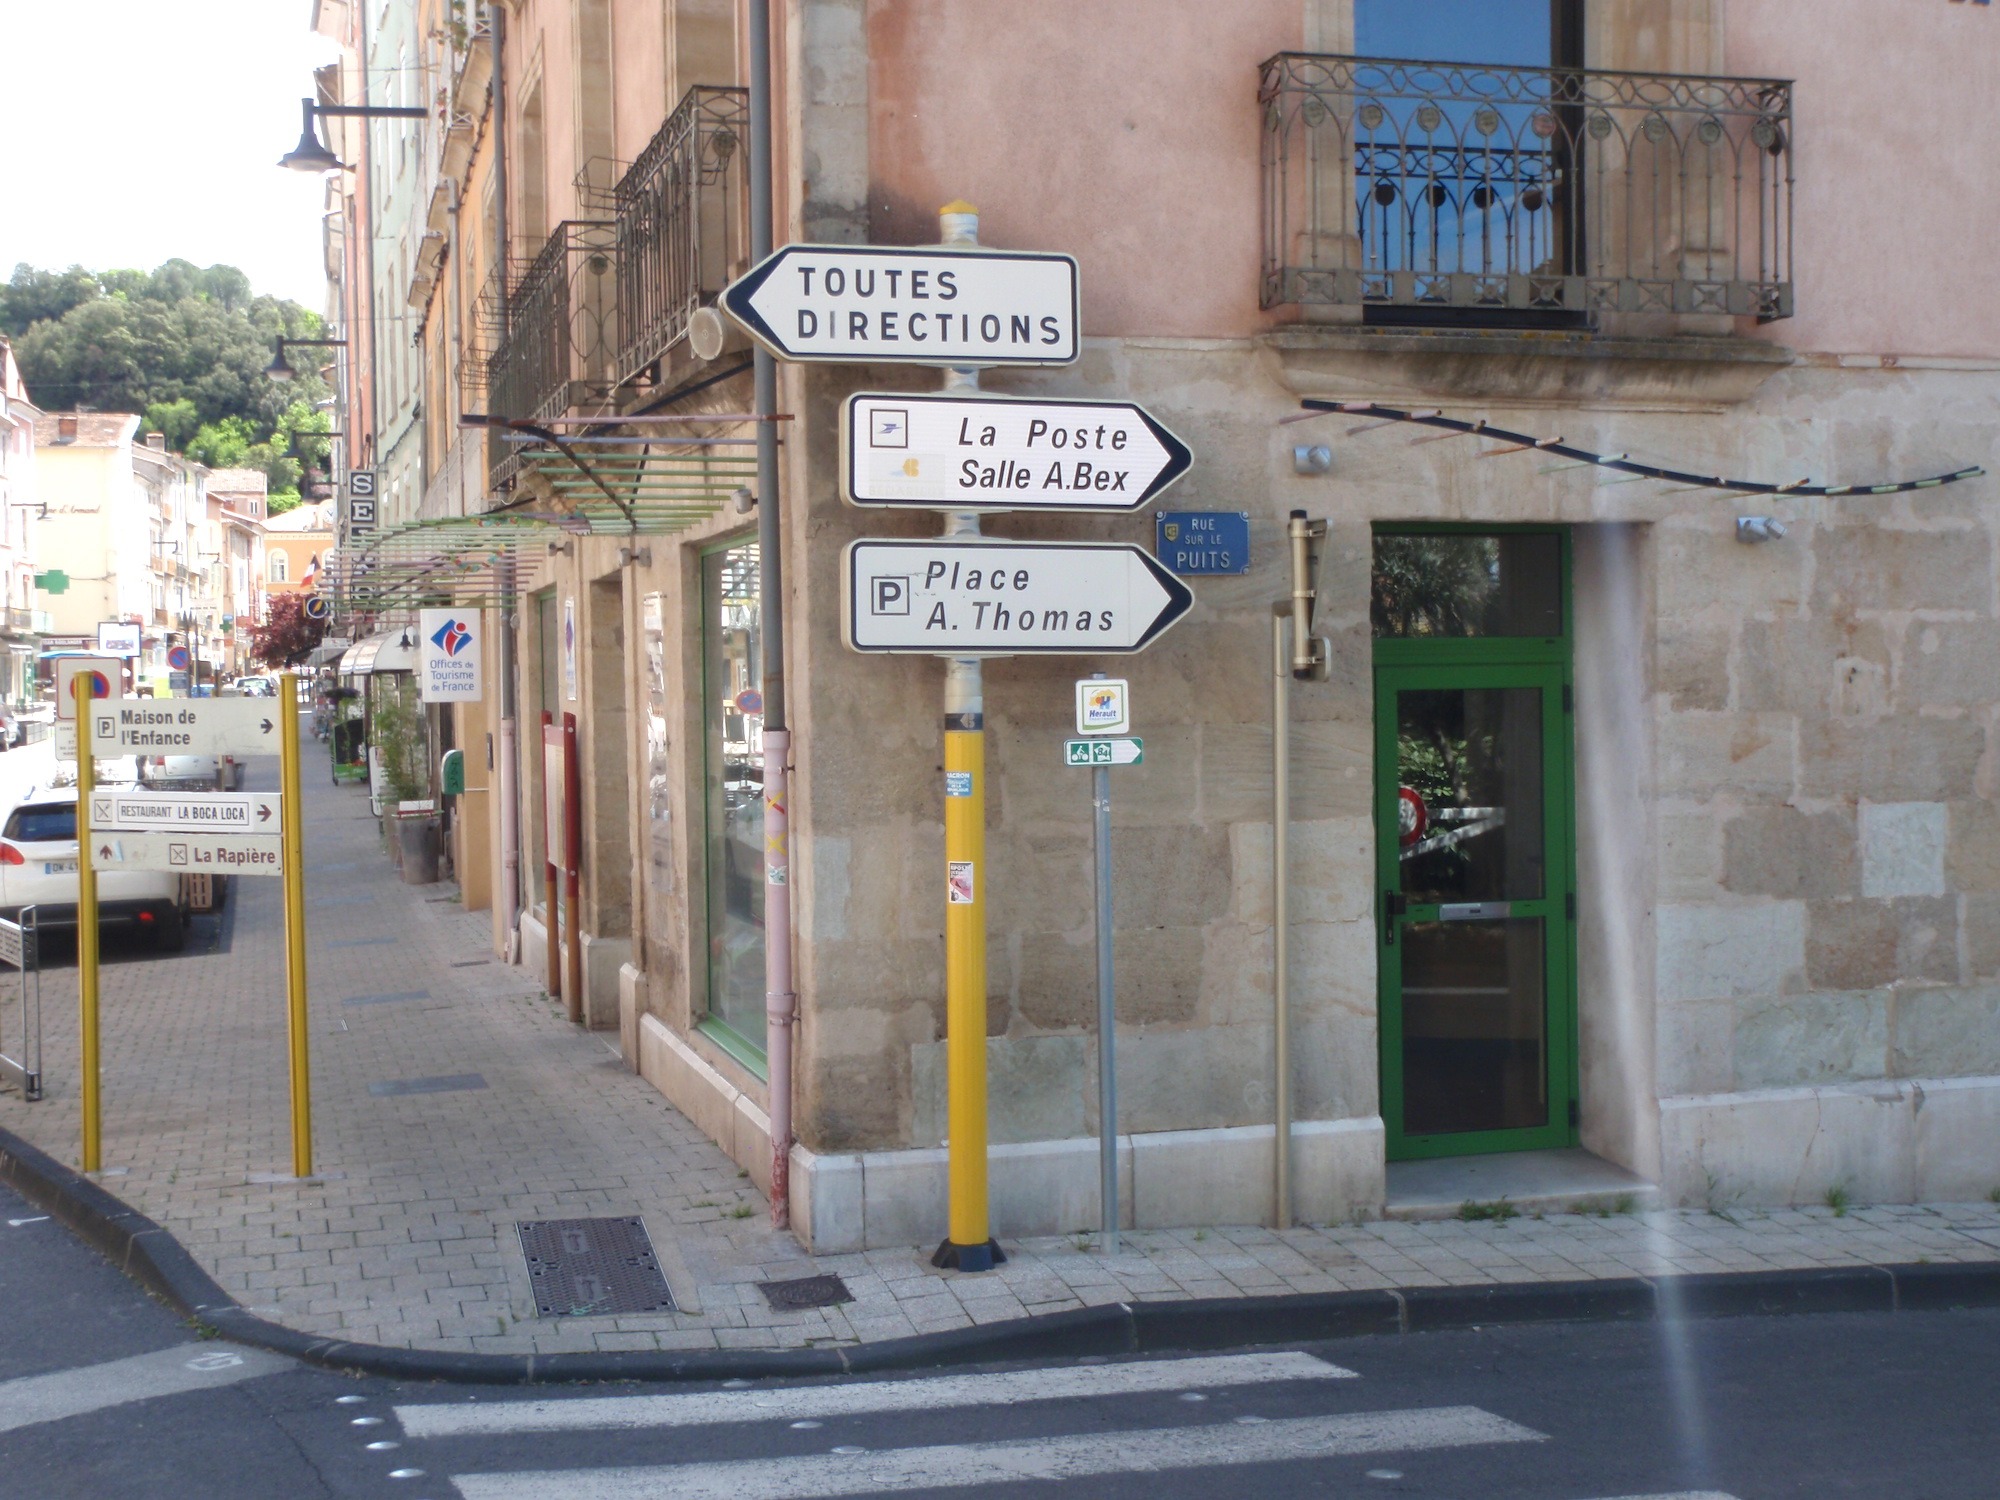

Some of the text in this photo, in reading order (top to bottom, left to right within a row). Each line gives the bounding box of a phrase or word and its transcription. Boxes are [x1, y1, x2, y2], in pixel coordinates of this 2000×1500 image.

[798, 267, 958, 300] TOUTES
[798, 309, 1060, 345] DIRECTIONS
[959, 417, 1127, 451] La Poste
[959, 459, 1129, 492] Salle A.Bex
[1191, 518, 1215, 531] RUE
[1185, 534, 1222, 545] SUR LE
[1177, 551, 1230, 569] PUITS
[924, 560, 1029, 591] Place
[878, 581, 902, 611] P
[925, 601, 1113, 632] A. Thomas
[430, 659, 474, 669] Offices de
[430, 670, 475, 680] Tourisme
[442, 681, 475, 691] France
[121, 709, 196, 725] Maison de
[102, 720, 110, 734] P
[121, 731, 191, 746] l'Enfance
[121, 802, 245, 821] RESTAURANT LA BOCA LOCA
[195, 847, 276, 867] La Rapière
